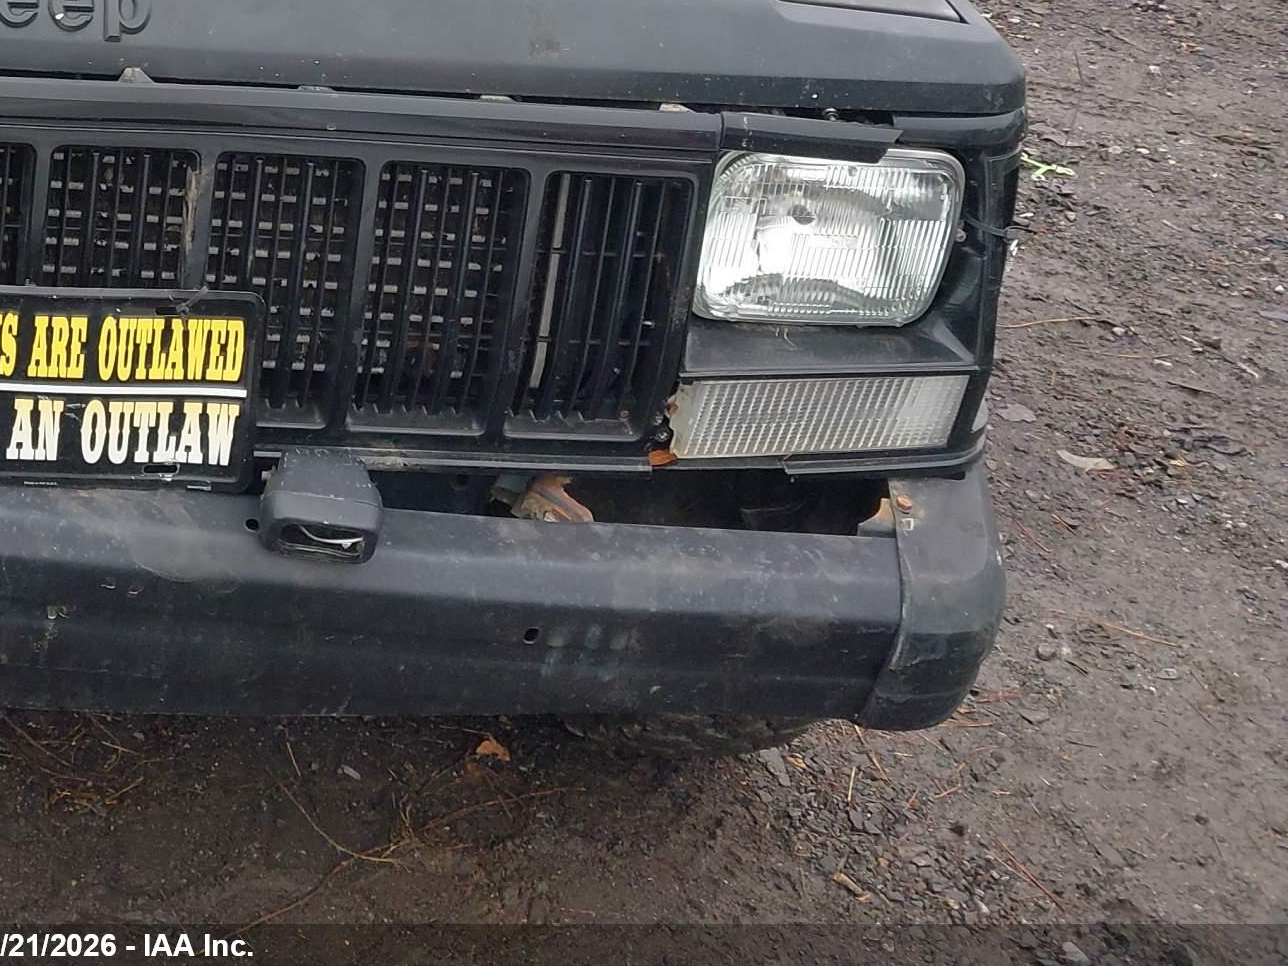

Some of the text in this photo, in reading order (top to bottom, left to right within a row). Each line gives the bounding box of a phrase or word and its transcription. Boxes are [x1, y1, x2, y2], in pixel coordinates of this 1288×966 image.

[26, 314, 89, 380] ARE
[97, 315, 246, 382] OUTLAWED
[5, 397, 65, 462] AN
[79, 398, 241, 467] OUTLAW
